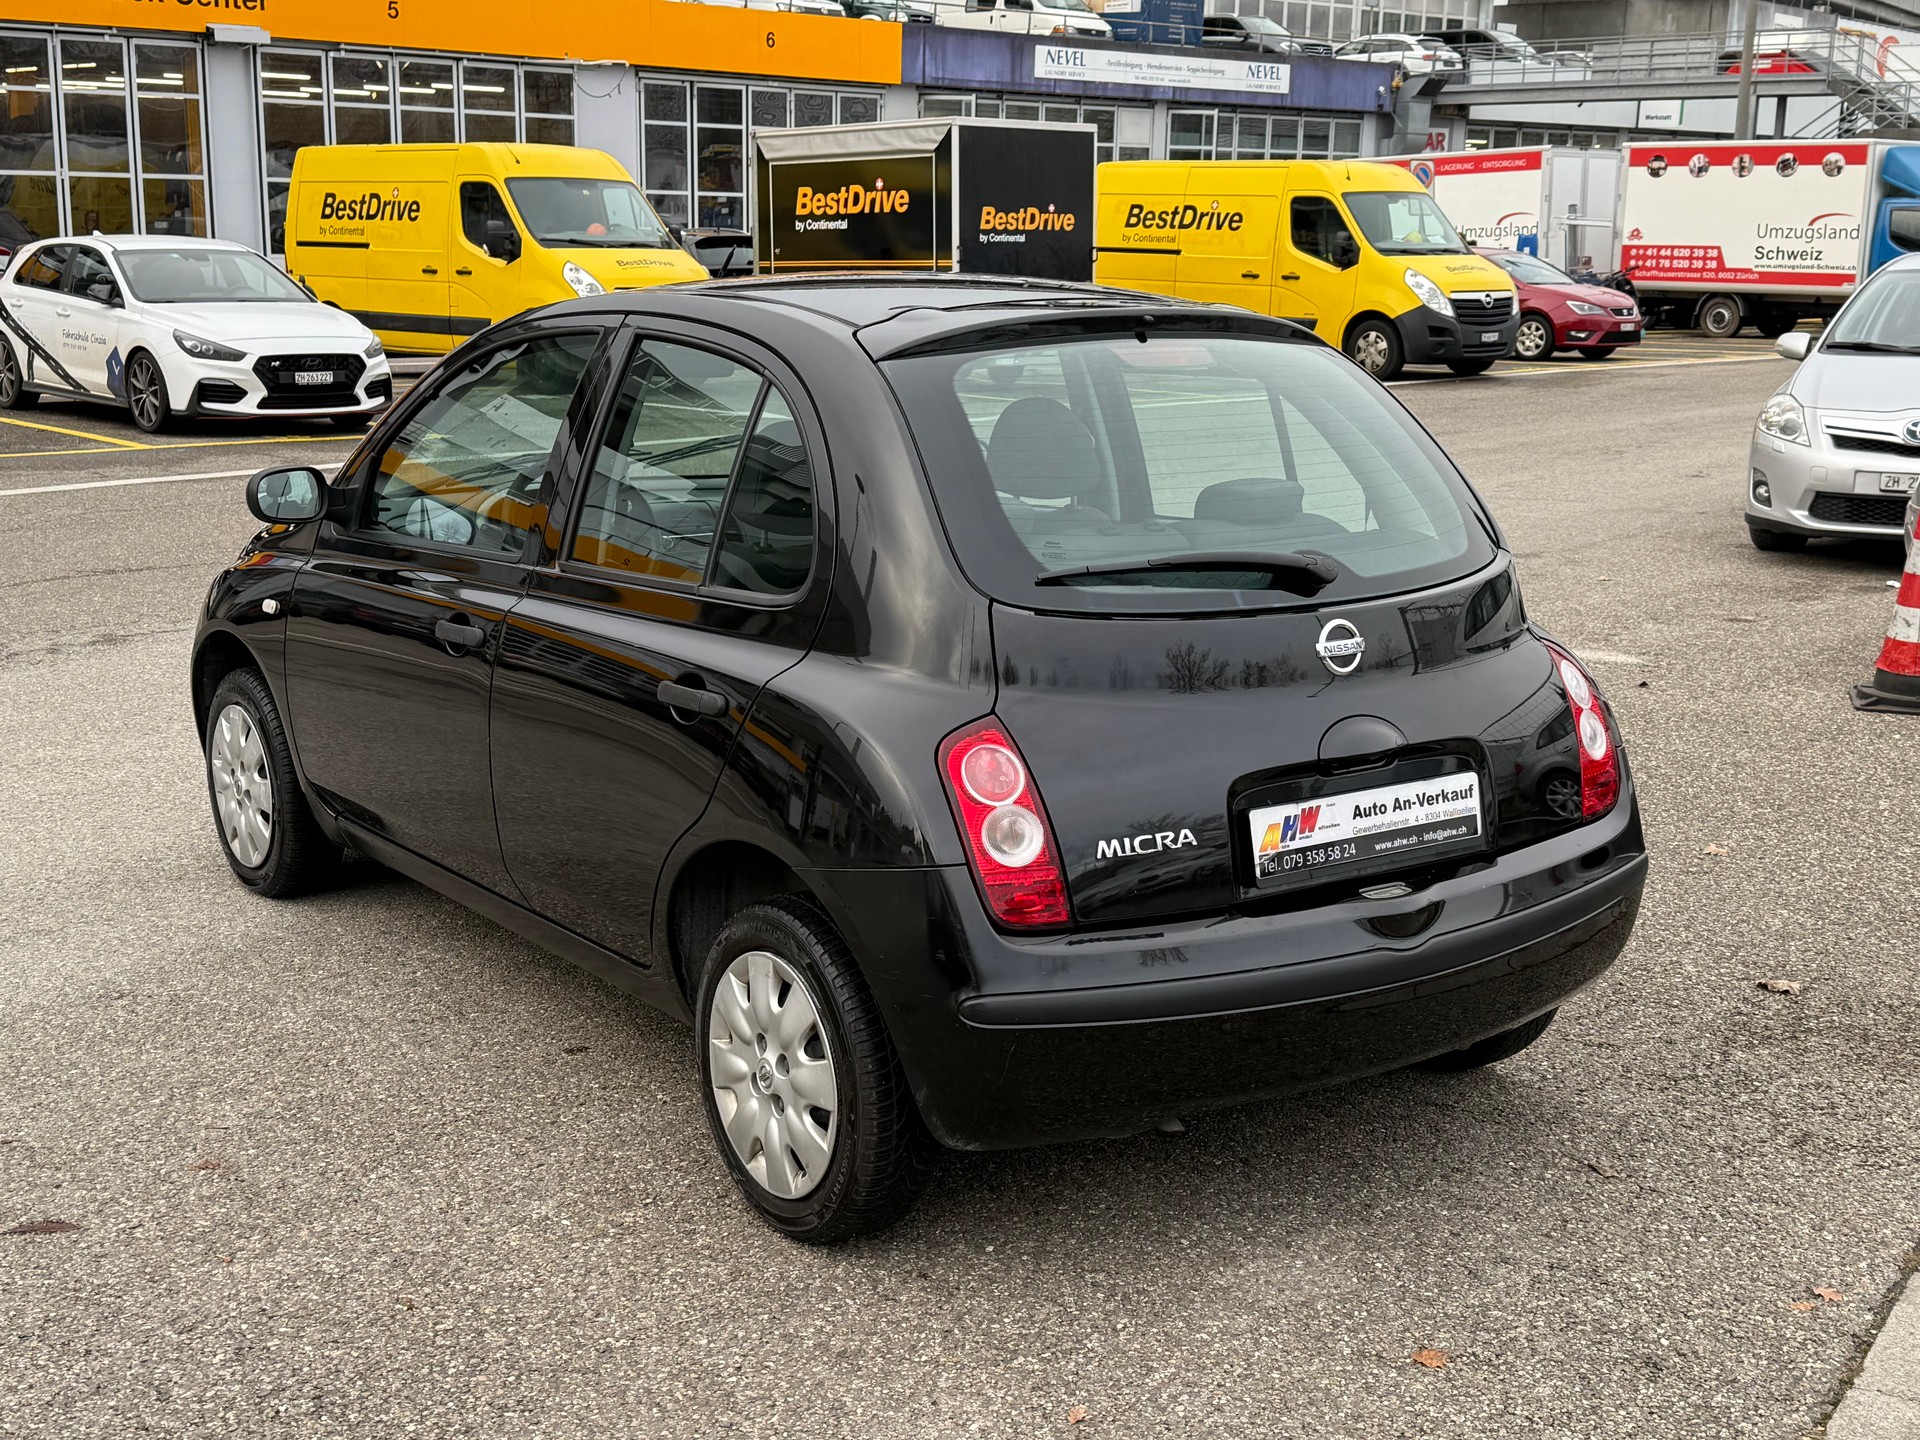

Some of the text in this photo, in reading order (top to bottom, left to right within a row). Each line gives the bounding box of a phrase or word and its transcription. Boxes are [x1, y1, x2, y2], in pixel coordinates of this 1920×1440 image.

[387, 1, 399, 19] 5
[766, 31, 776, 48] 6
[1045, 49, 1086, 67] NEVEL
[1246, 64, 1282, 81] NEVEL
[1440, 162, 1475, 172] LAGERUNG
[1482, 159, 1527, 169] ENTSORGUNG
[320, 187, 420, 222] BestDrive
[795, 178, 910, 216] BestDrive
[980, 204, 1075, 231] BestDrive
[1124, 200, 1244, 232] BestDrive
[319, 225, 365, 237] by Continental
[795, 218, 848, 232] by Continental
[1757, 223, 1861, 244] Umzugsland
[979, 233, 1026, 244] by Continental
[1122, 233, 1176, 244] by Continental
[1646, 248, 1657, 256] 41
[1660, 248, 1671, 256] 44
[1673, 248, 1690, 257] 620
[1692, 248, 1704, 257] 39
[1706, 248, 1718, 257] 38
[1754, 245, 1824, 261] Schweiz
[1645, 259, 1656, 267] 41
[1659, 259, 1670, 268] 76
[1672, 260, 1690, 268] 520
[1691, 260, 1703, 268] 39
[1705, 260, 1717, 269] 38
[1634, 270, 1701, 278] Schaffhauserstrasse
[1718, 271, 1735, 279] 8052
[1736, 272, 1760, 280] Zürich
[62, 328, 107, 345] Fahrschule Cinzia
[296, 373, 306, 382] ZH
[1885, 475, 1920, 489] ZH 2
[1323, 640, 1363, 655] NISSAN
[1352, 783, 1474, 820] Auto An-Verkauf
[1425, 812, 1441, 822] 8304
[1259, 804, 1322, 853] AHW
[1096, 828, 1198, 860] MICRA
[1374, 835, 1418, 851] www.ahw.ch
[1423, 825, 1467, 840] info@ahw.ch
[1264, 842, 1357, 873] Tel. 079 358 58 24
